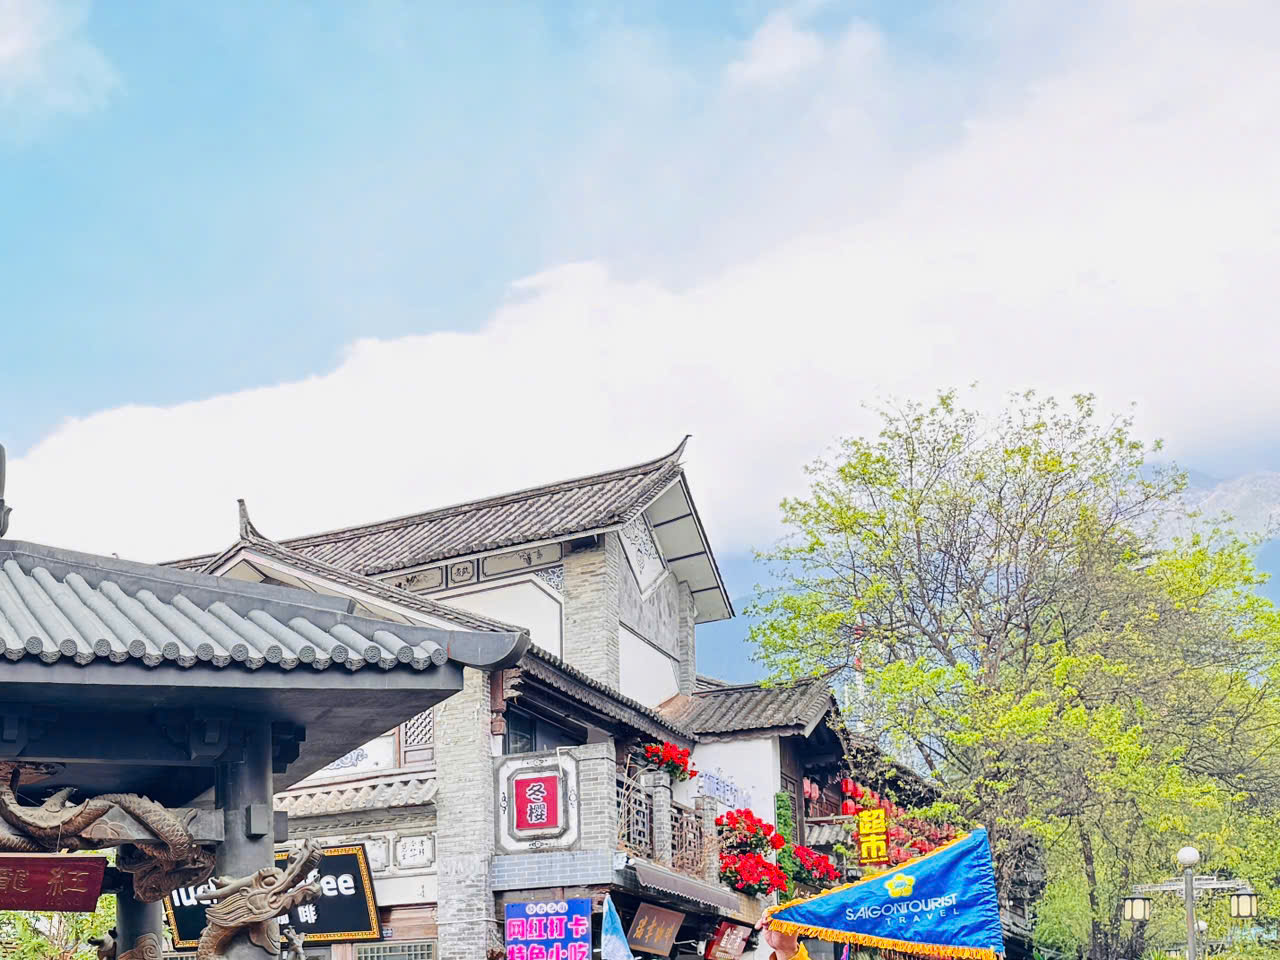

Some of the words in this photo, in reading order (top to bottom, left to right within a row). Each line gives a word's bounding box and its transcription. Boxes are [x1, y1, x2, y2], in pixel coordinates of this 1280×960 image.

[858, 808, 888, 858] 超市
[845, 893, 958, 921] SAIGONTOURIST
[885, 908, 960, 925] TRAVEL
[507, 915, 588, 940] 网红打卡
